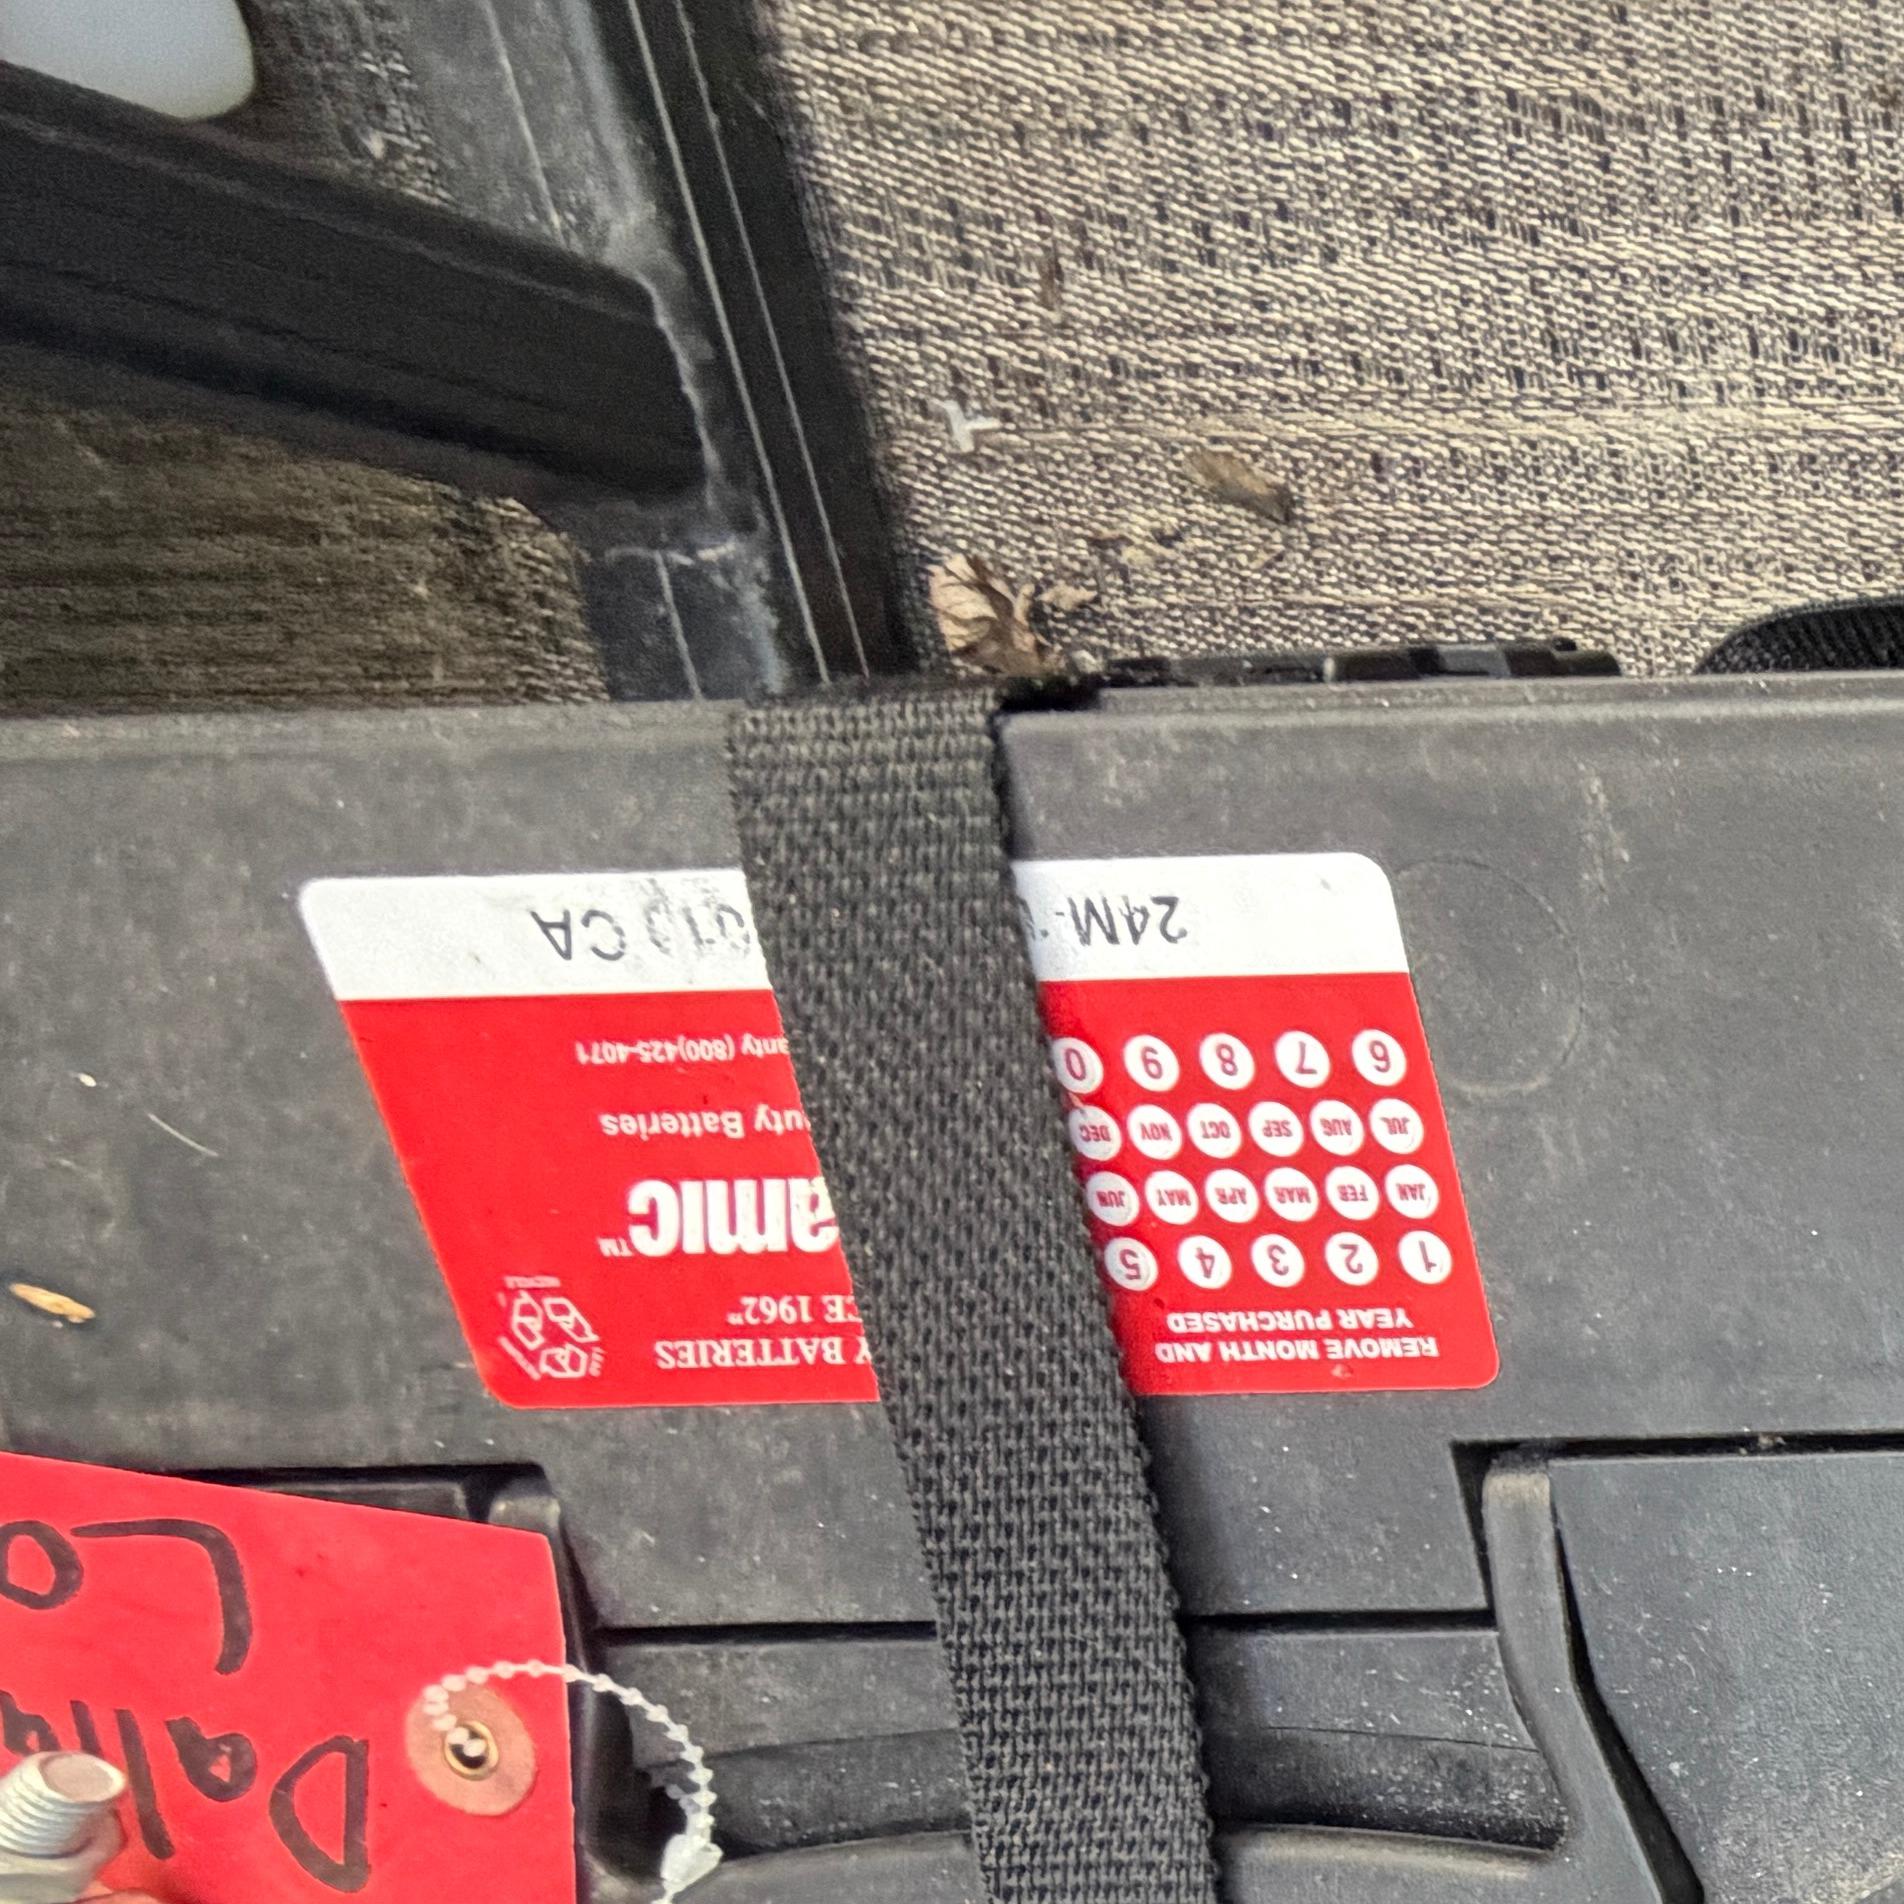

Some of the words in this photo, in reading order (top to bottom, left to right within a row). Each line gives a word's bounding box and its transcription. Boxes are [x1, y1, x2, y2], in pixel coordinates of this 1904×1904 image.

[530, 909, 625, 962] CA
[1064, 1047, 1086, 1081] 0
[1141, 1046, 1163, 1080] 9
[1215, 1043, 1238, 1077] 8
[1295, 1042, 1317, 1075] 7
[1370, 1040, 1390, 1073] 6
[599, 1111, 744, 1141] Batteries
[754, 1102, 807, 1135] uty
[1201, 1121, 1231, 1139] OCT
[1264, 1120, 1292, 1138] SEP
[1320, 1118, 1352, 1136] AUG
[1381, 1117, 1410, 1135] JUL
[1080, 1124, 1110, 1142] DEC
[1141, 1123, 1172, 1141] NOV
[1095, 1190, 1126, 1208] JUN
[1155, 1189, 1191, 1206] MAY
[1215, 1187, 1247, 1205] APR
[1274, 1186, 1311, 1203] MAR
[1337, 1184, 1368, 1202] FEB
[1396, 1183, 1426, 1201] JAN
[1120, 1248, 1141, 1280] 5
[1195, 1247, 1215, 1278] 4
[1266, 1244, 1289, 1276] 3
[1340, 1243, 1363, 1274] 2
[1418, 1240, 1436, 1273] 1
[1166, 1310, 1333, 1333] PURCHASED
[1337, 1308, 1414, 1329] YEAR
[654, 1337, 845, 1369] BATTERIES
[1154, 1342, 1211, 1363] AND
[1222, 1339, 1320, 1361] MONTH
[1323, 1336, 1440, 1359] REMOVE
